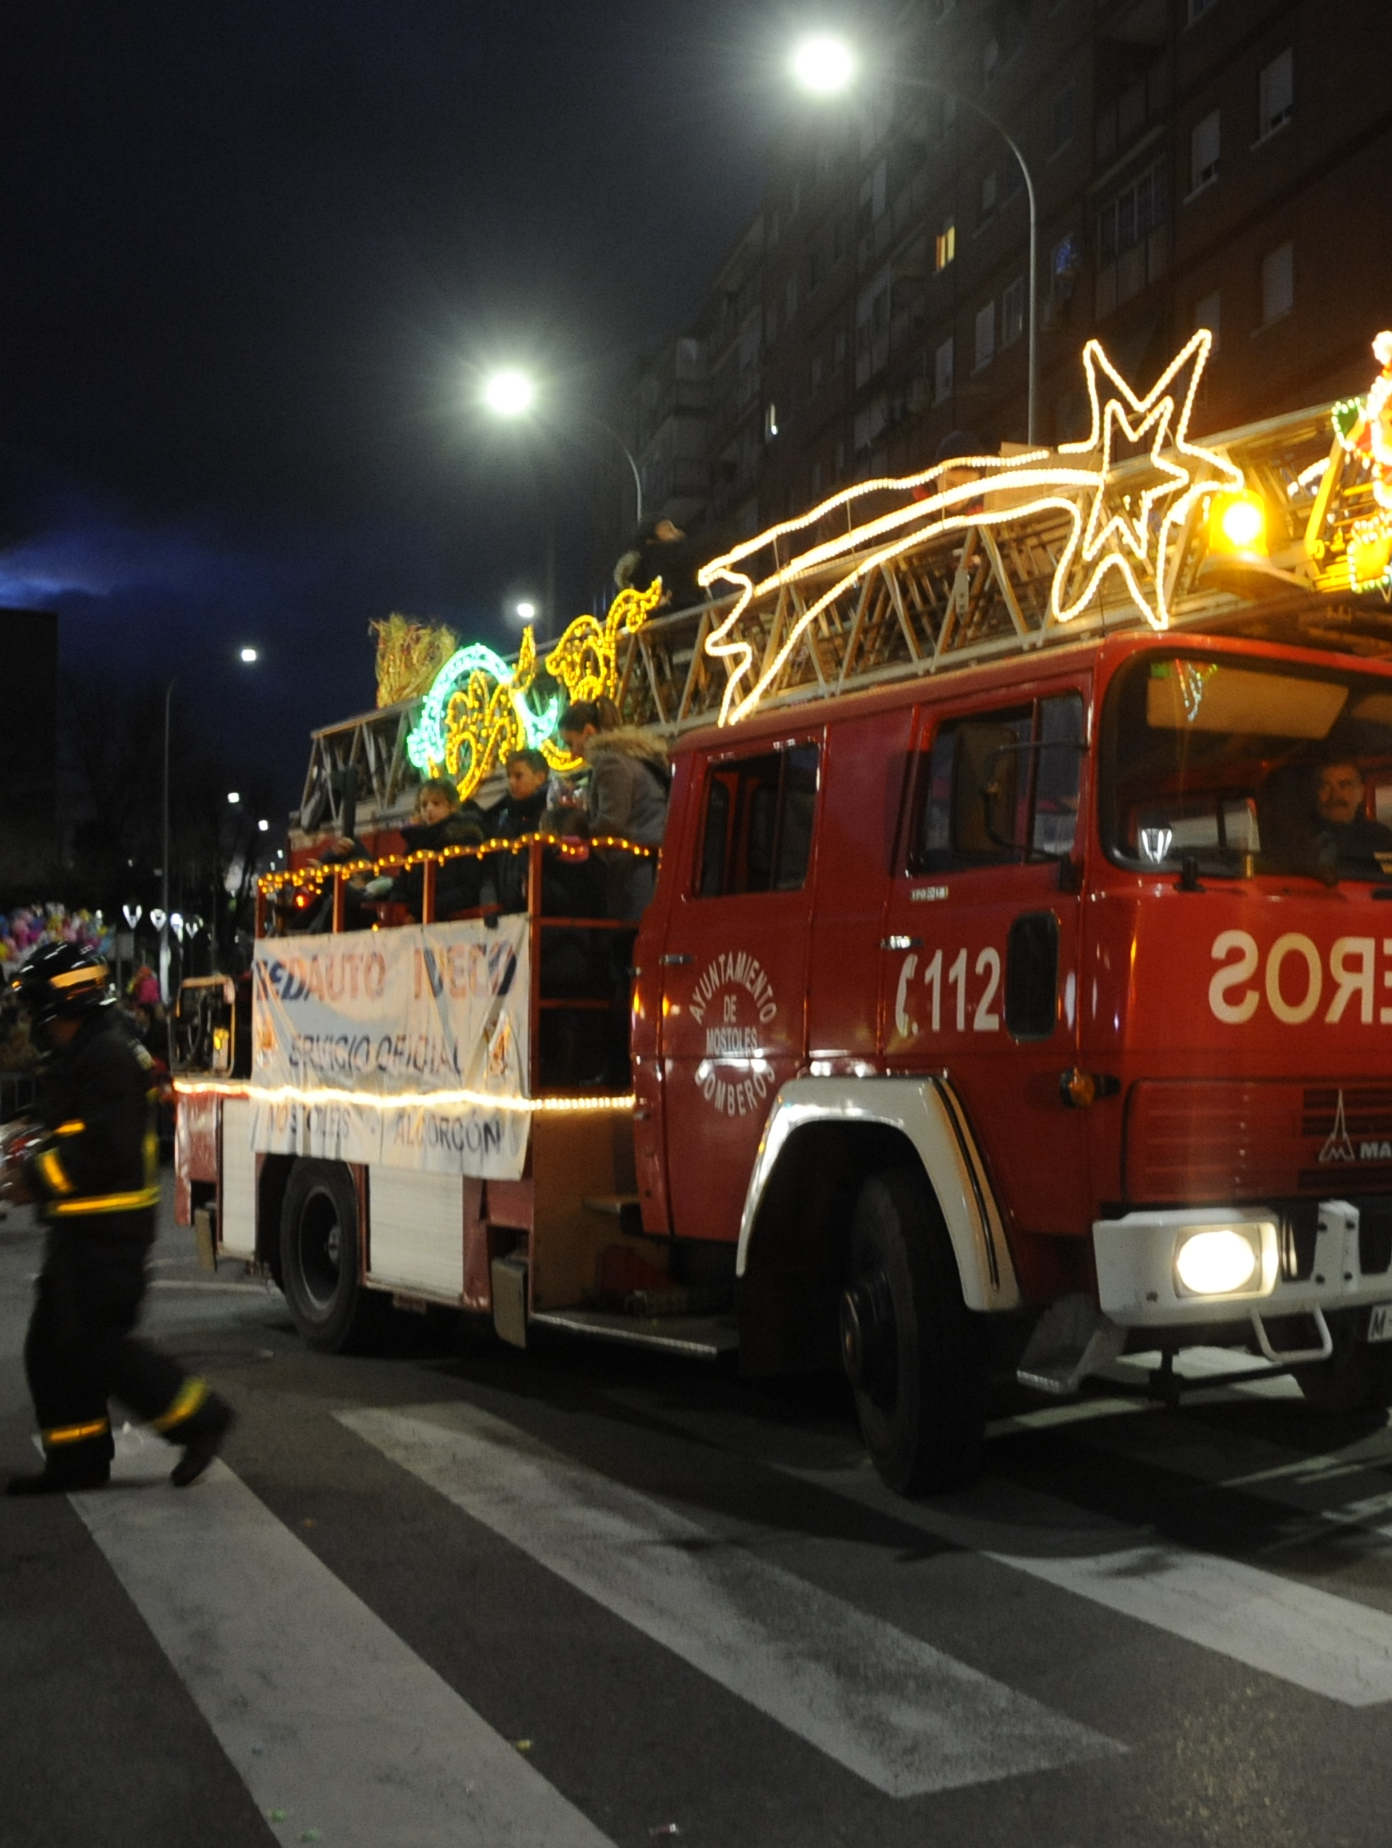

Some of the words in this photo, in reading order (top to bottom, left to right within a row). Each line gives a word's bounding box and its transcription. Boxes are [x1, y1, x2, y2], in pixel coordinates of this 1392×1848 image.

[689, 951, 777, 1025] AYUNTAMIENTO
[723, 994, 738, 1024] DE
[924, 947, 1000, 1033] 112
[375, 1033, 462, 1075] OFICIAL
[706, 1026, 758, 1057] MOSTOLES
